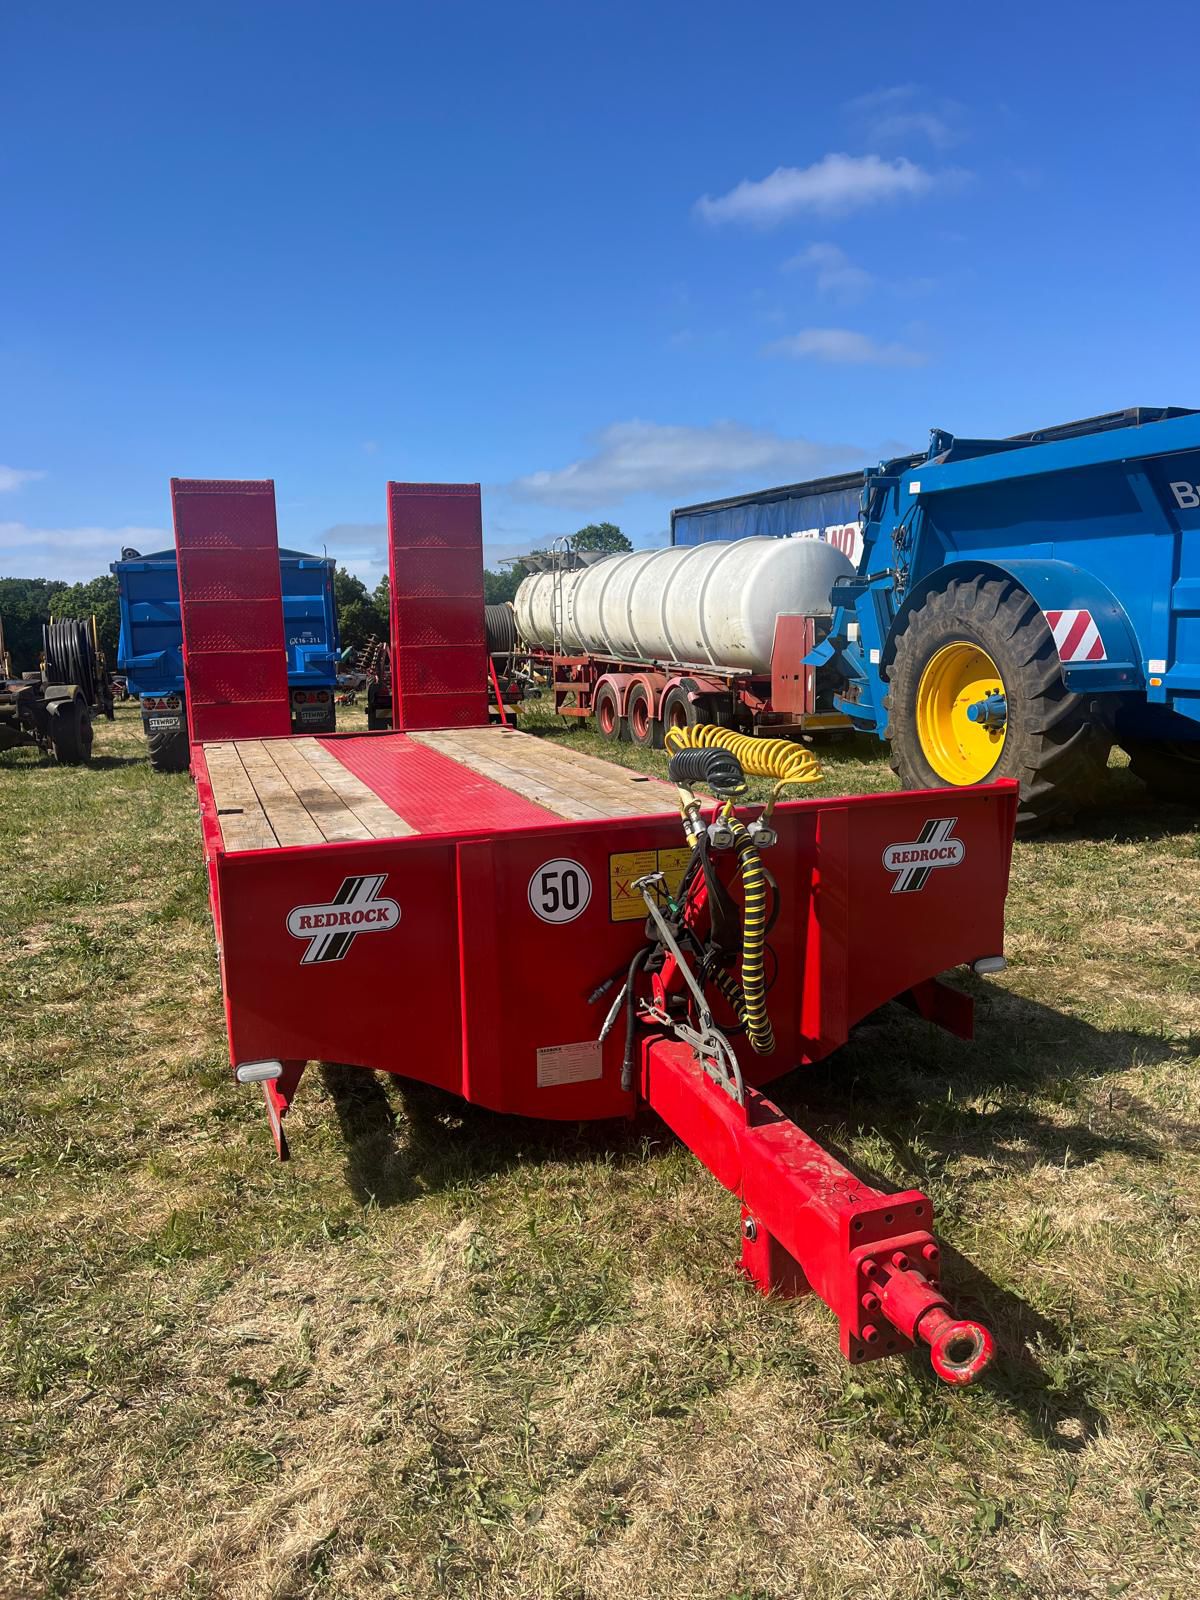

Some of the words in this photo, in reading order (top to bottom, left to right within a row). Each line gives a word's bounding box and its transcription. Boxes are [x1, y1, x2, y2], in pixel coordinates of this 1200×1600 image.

[891, 846, 957, 865] REDROCK
[541, 869, 580, 913] 50
[298, 907, 390, 930] REDROCK
